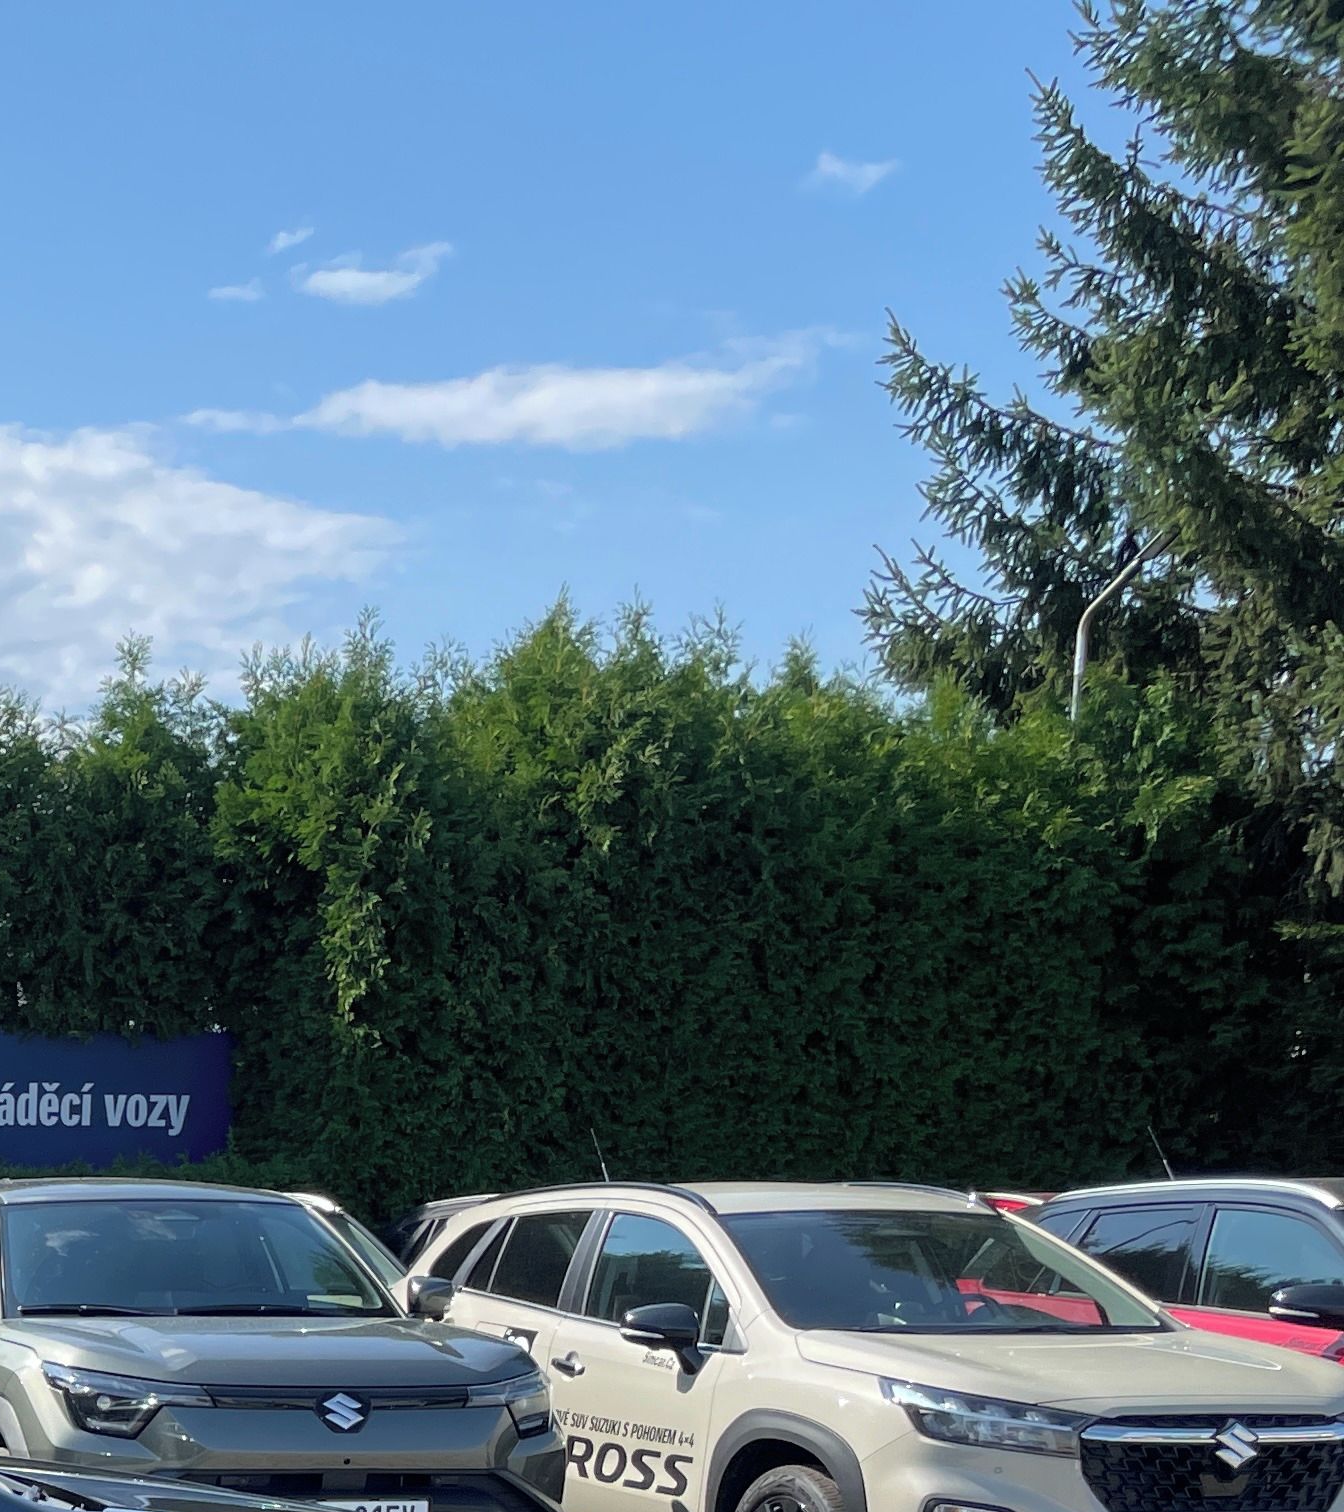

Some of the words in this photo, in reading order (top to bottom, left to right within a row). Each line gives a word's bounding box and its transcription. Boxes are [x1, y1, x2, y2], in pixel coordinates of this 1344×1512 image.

[104, 1094, 191, 1136] vozy
[556, 1408, 570, 1426] VÉ
[570, 1412, 590, 1430] SUV
[590, 1415, 622, 1436] SUZUKI
[622, 1422, 630, 1437] S
[630, 1423, 678, 1446] POHONEM
[566, 1435, 694, 1497] ROSS
